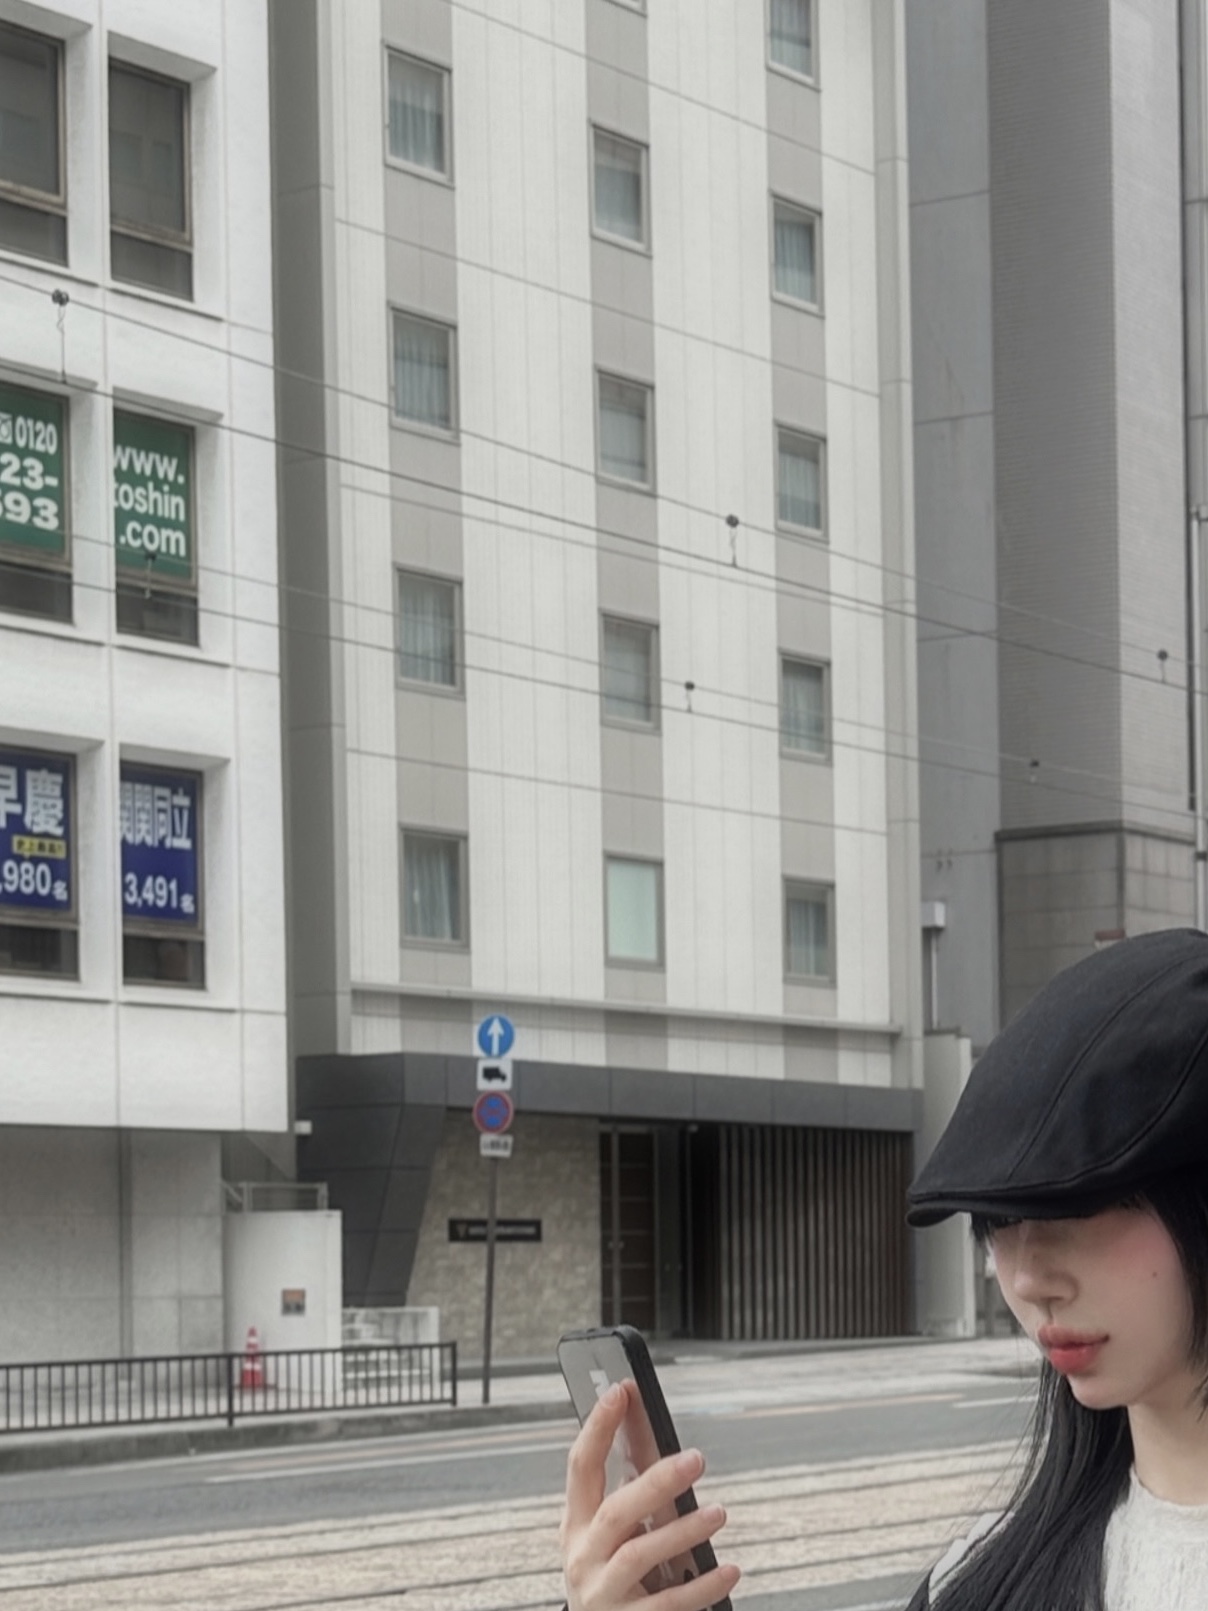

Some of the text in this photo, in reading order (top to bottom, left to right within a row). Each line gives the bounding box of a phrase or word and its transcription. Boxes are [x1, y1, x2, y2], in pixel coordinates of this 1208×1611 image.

[15, 416, 58, 455] 0120
[0, 490, 60, 532] 93
[119, 520, 186, 558] .com
